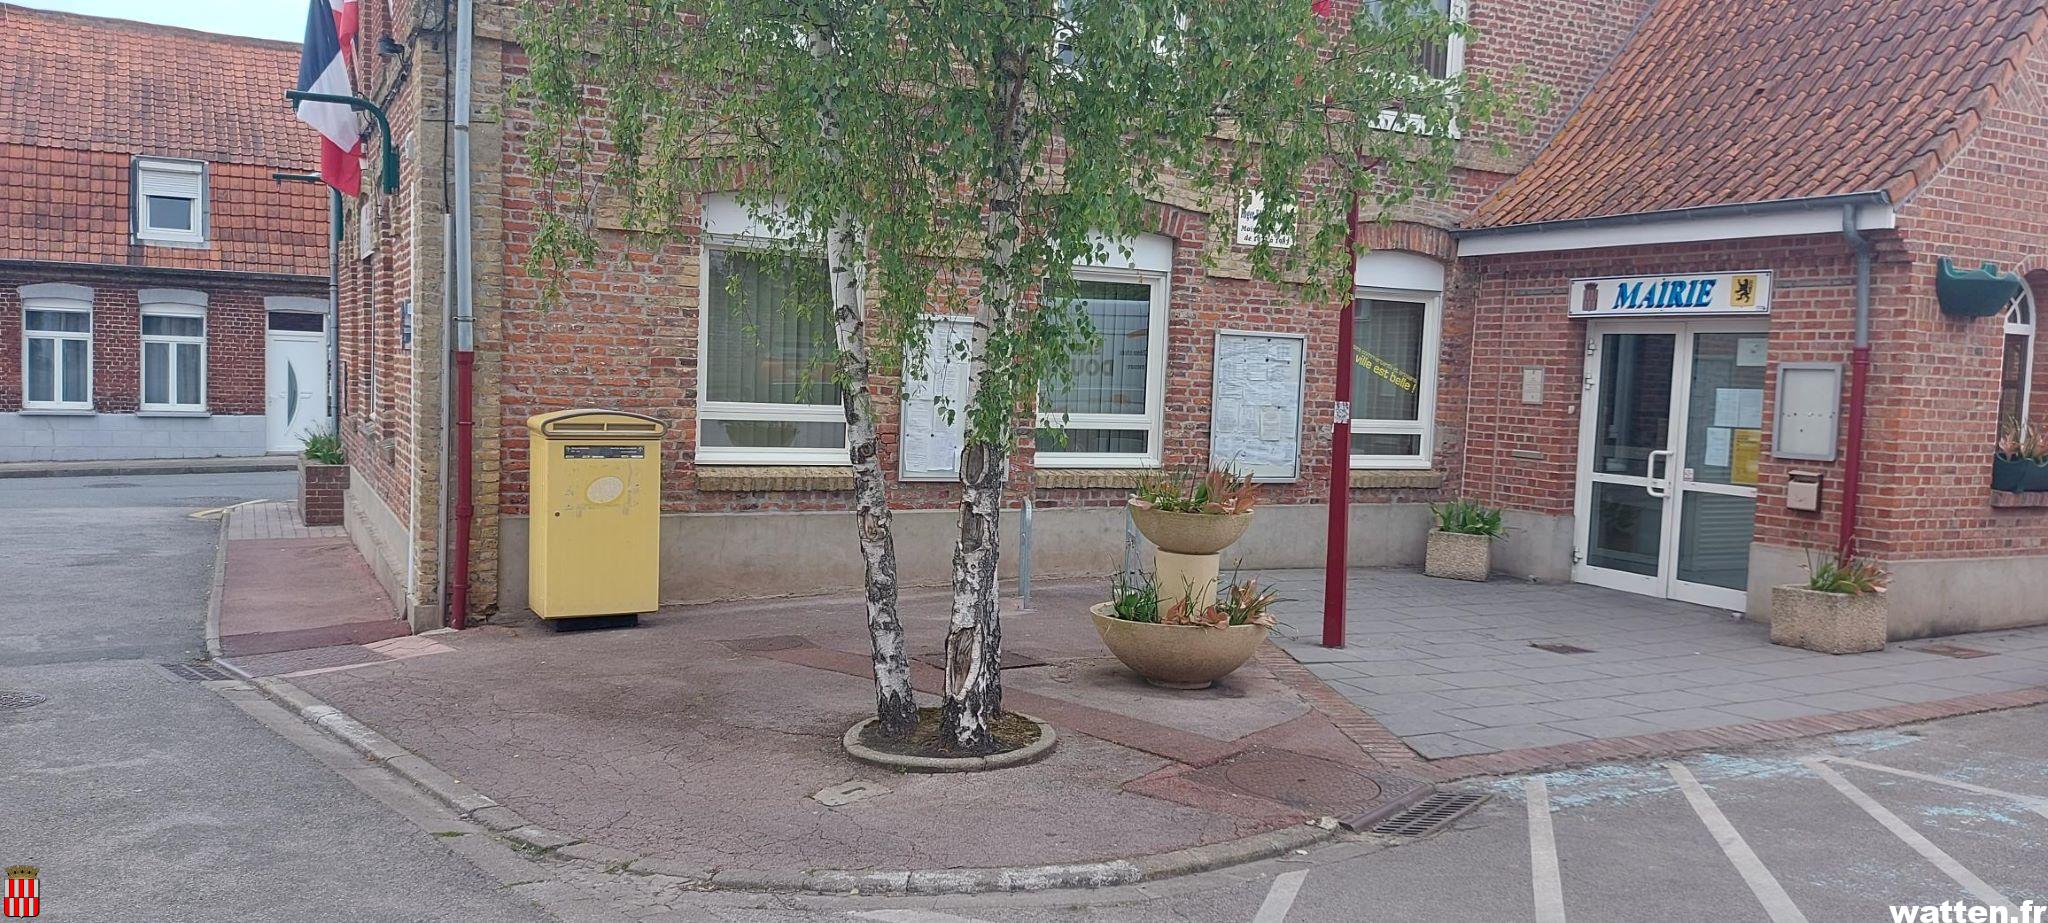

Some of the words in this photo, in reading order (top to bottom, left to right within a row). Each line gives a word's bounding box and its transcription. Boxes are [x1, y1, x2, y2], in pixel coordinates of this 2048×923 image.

[1611, 278, 1717, 310] MAIRIE
[1355, 354, 1372, 370] ville
[1373, 365, 1390, 379] est
[1389, 371, 1411, 391] belle
